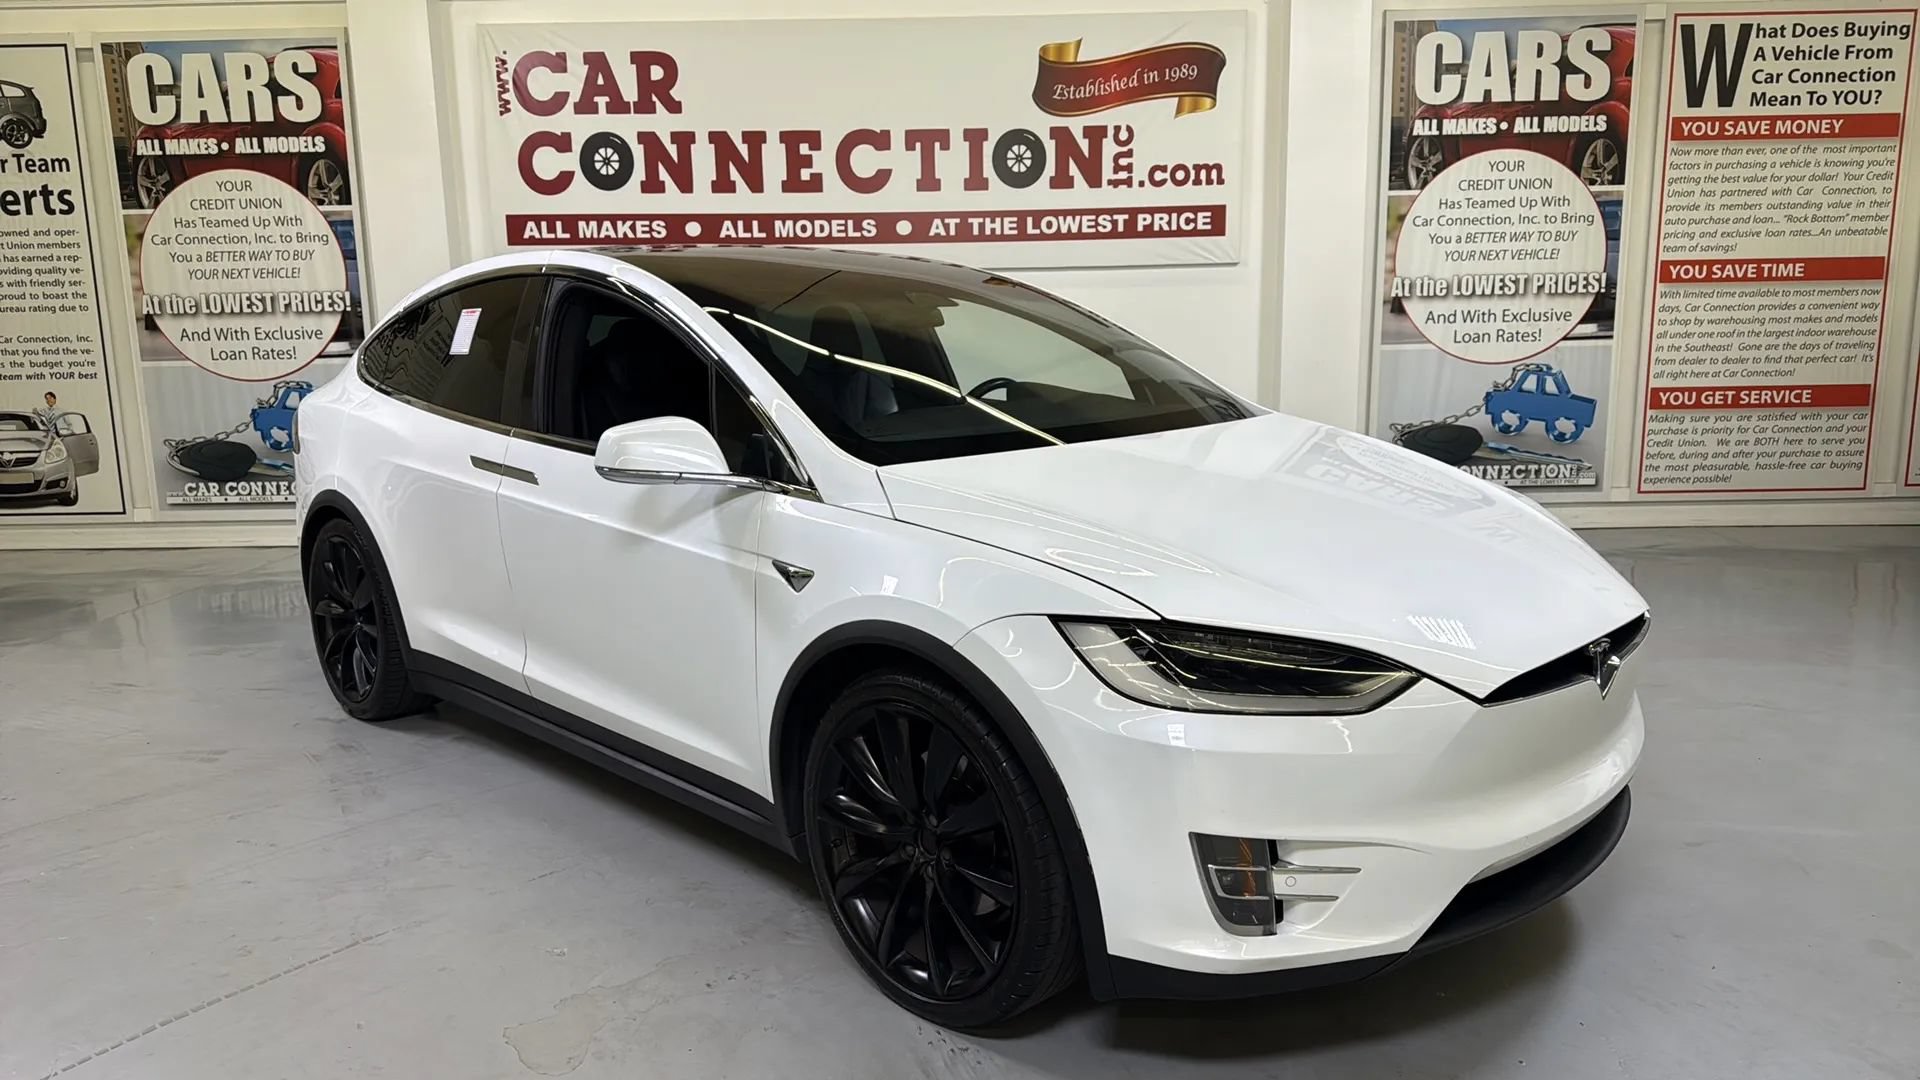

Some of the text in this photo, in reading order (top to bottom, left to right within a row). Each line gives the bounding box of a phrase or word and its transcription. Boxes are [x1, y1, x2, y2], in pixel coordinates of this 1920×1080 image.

[1791, 23, 1839, 38] Does
[1844, 21, 1911, 40] Buying
[1753, 45, 1893, 62] A Vehicle From
[1414, 27, 1612, 106] CARS
[495, 50, 511, 117] www.
[512, 50, 683, 117] CAR
[1052, 64, 1199, 101] Established in 1989
[1752, 67, 1896, 84] Car Connection
[127, 50, 322, 125] CARS
[1749, 89, 1882, 107] Mean To YOU?
[1412, 115, 1607, 136] ALL MAKES ALL MODELS
[1681, 119, 1844, 136] YOU SAVE MONEY
[136, 136, 325, 155] ALL MAKES ALL MODELS
[1670, 144, 1897, 157] Now more than ever, one of the most important
[12, 153, 71, 173] Team
[517, 125, 1109, 196] CONNECTION
[1488, 160, 1525, 172] YOUR
[1137, 162, 1226, 188] .com
[216, 180, 253, 192] YOUR
[1458, 178, 1553, 191] CREDIT UNION
[190, 198, 282, 210] CREDIT UNION
[1439, 195, 1570, 211] Has Teamed Up With
[174, 215, 303, 229] Has Teamed Up With
[523, 212, 1212, 239] ALL MAKES ALL MODELS AT THE LOWEST PRICE
[1412, 212, 1595, 227] Car Connection, Inc. to Bring
[33, 228, 51, 237] and
[54, 229, 80, 238] oper-
[151, 232, 329, 246] Car Connection, Inc. to Bring
[1429, 230, 1579, 244] You a BETTER WAY TO BUY
[7, 241, 81, 249] Union members
[1662, 242, 1737, 254] team of savings!
[169, 249, 315, 263] You a BETTER WAY TO BUY
[1444, 248, 1560, 262] YOUR NEXT VEHICLE!
[188, 267, 301, 280] YOUR NEXT VEHICLE!
[1670, 263, 1805, 279] YOU SAVE TIME
[1391, 272, 1608, 297] At the LOWEST PRICES!
[1660, 287, 1881, 299] With limited time available to most members now
[142, 291, 351, 315] At the LOWEST PRICES!
[1425, 307, 1573, 325] And With Exclusive
[17, 335, 73, 344] Connection,
[76, 334, 93, 342] Inc.
[180, 326, 323, 342] And With Exclusive
[1453, 328, 1542, 344] Loan Rates!
[210, 346, 297, 361] Loan Rates!
[10, 359, 96, 369] the budget you're
[26, 372, 45, 380] with
[49, 371, 75, 379] YOUR
[78, 371, 98, 379] best
[1659, 389, 1812, 405] YOU GET SERVICE
[1643, 474, 1732, 485] experience possible!
[184, 482, 220, 496] CAR
